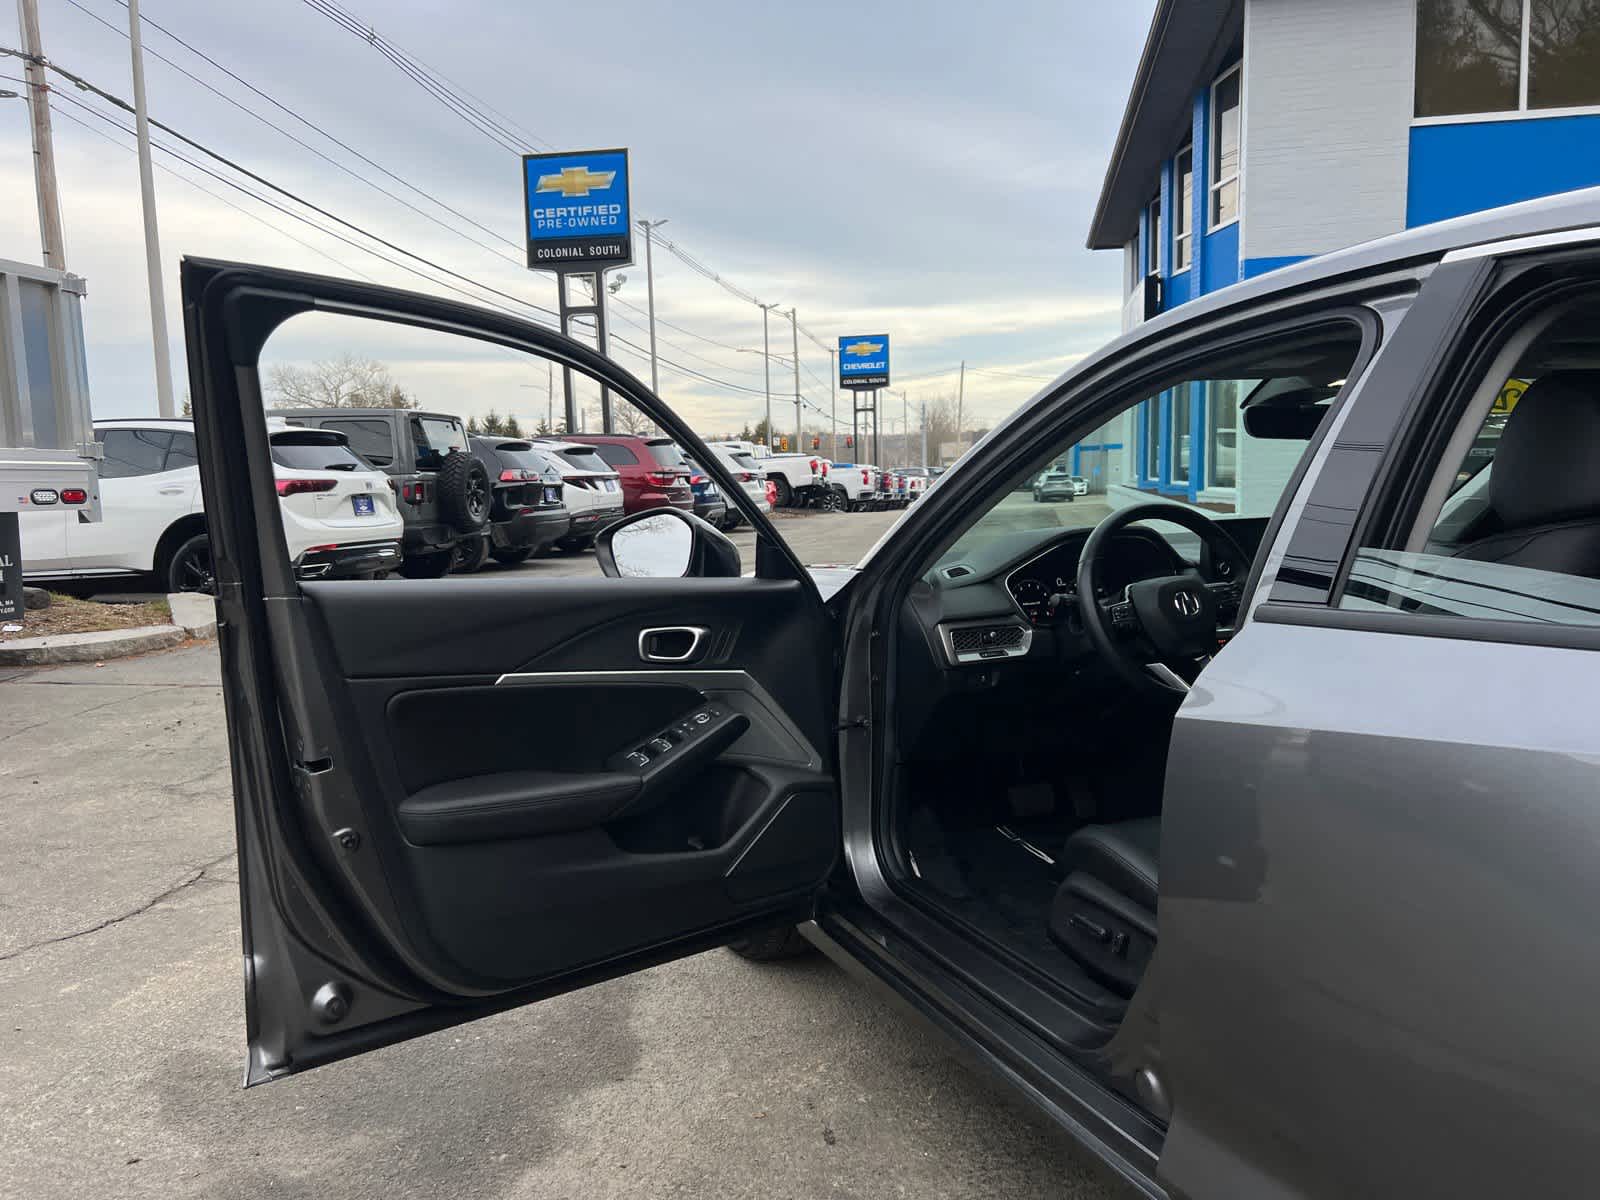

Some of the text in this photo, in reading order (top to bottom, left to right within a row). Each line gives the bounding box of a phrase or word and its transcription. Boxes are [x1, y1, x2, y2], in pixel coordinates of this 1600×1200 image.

[533, 203, 621, 219] CERTIFIED
[538, 215, 617, 229] PRE-OWNED
[537, 245, 621, 258] COLONIAL SOUTH
[843, 361, 886, 370] CHEVROLET
